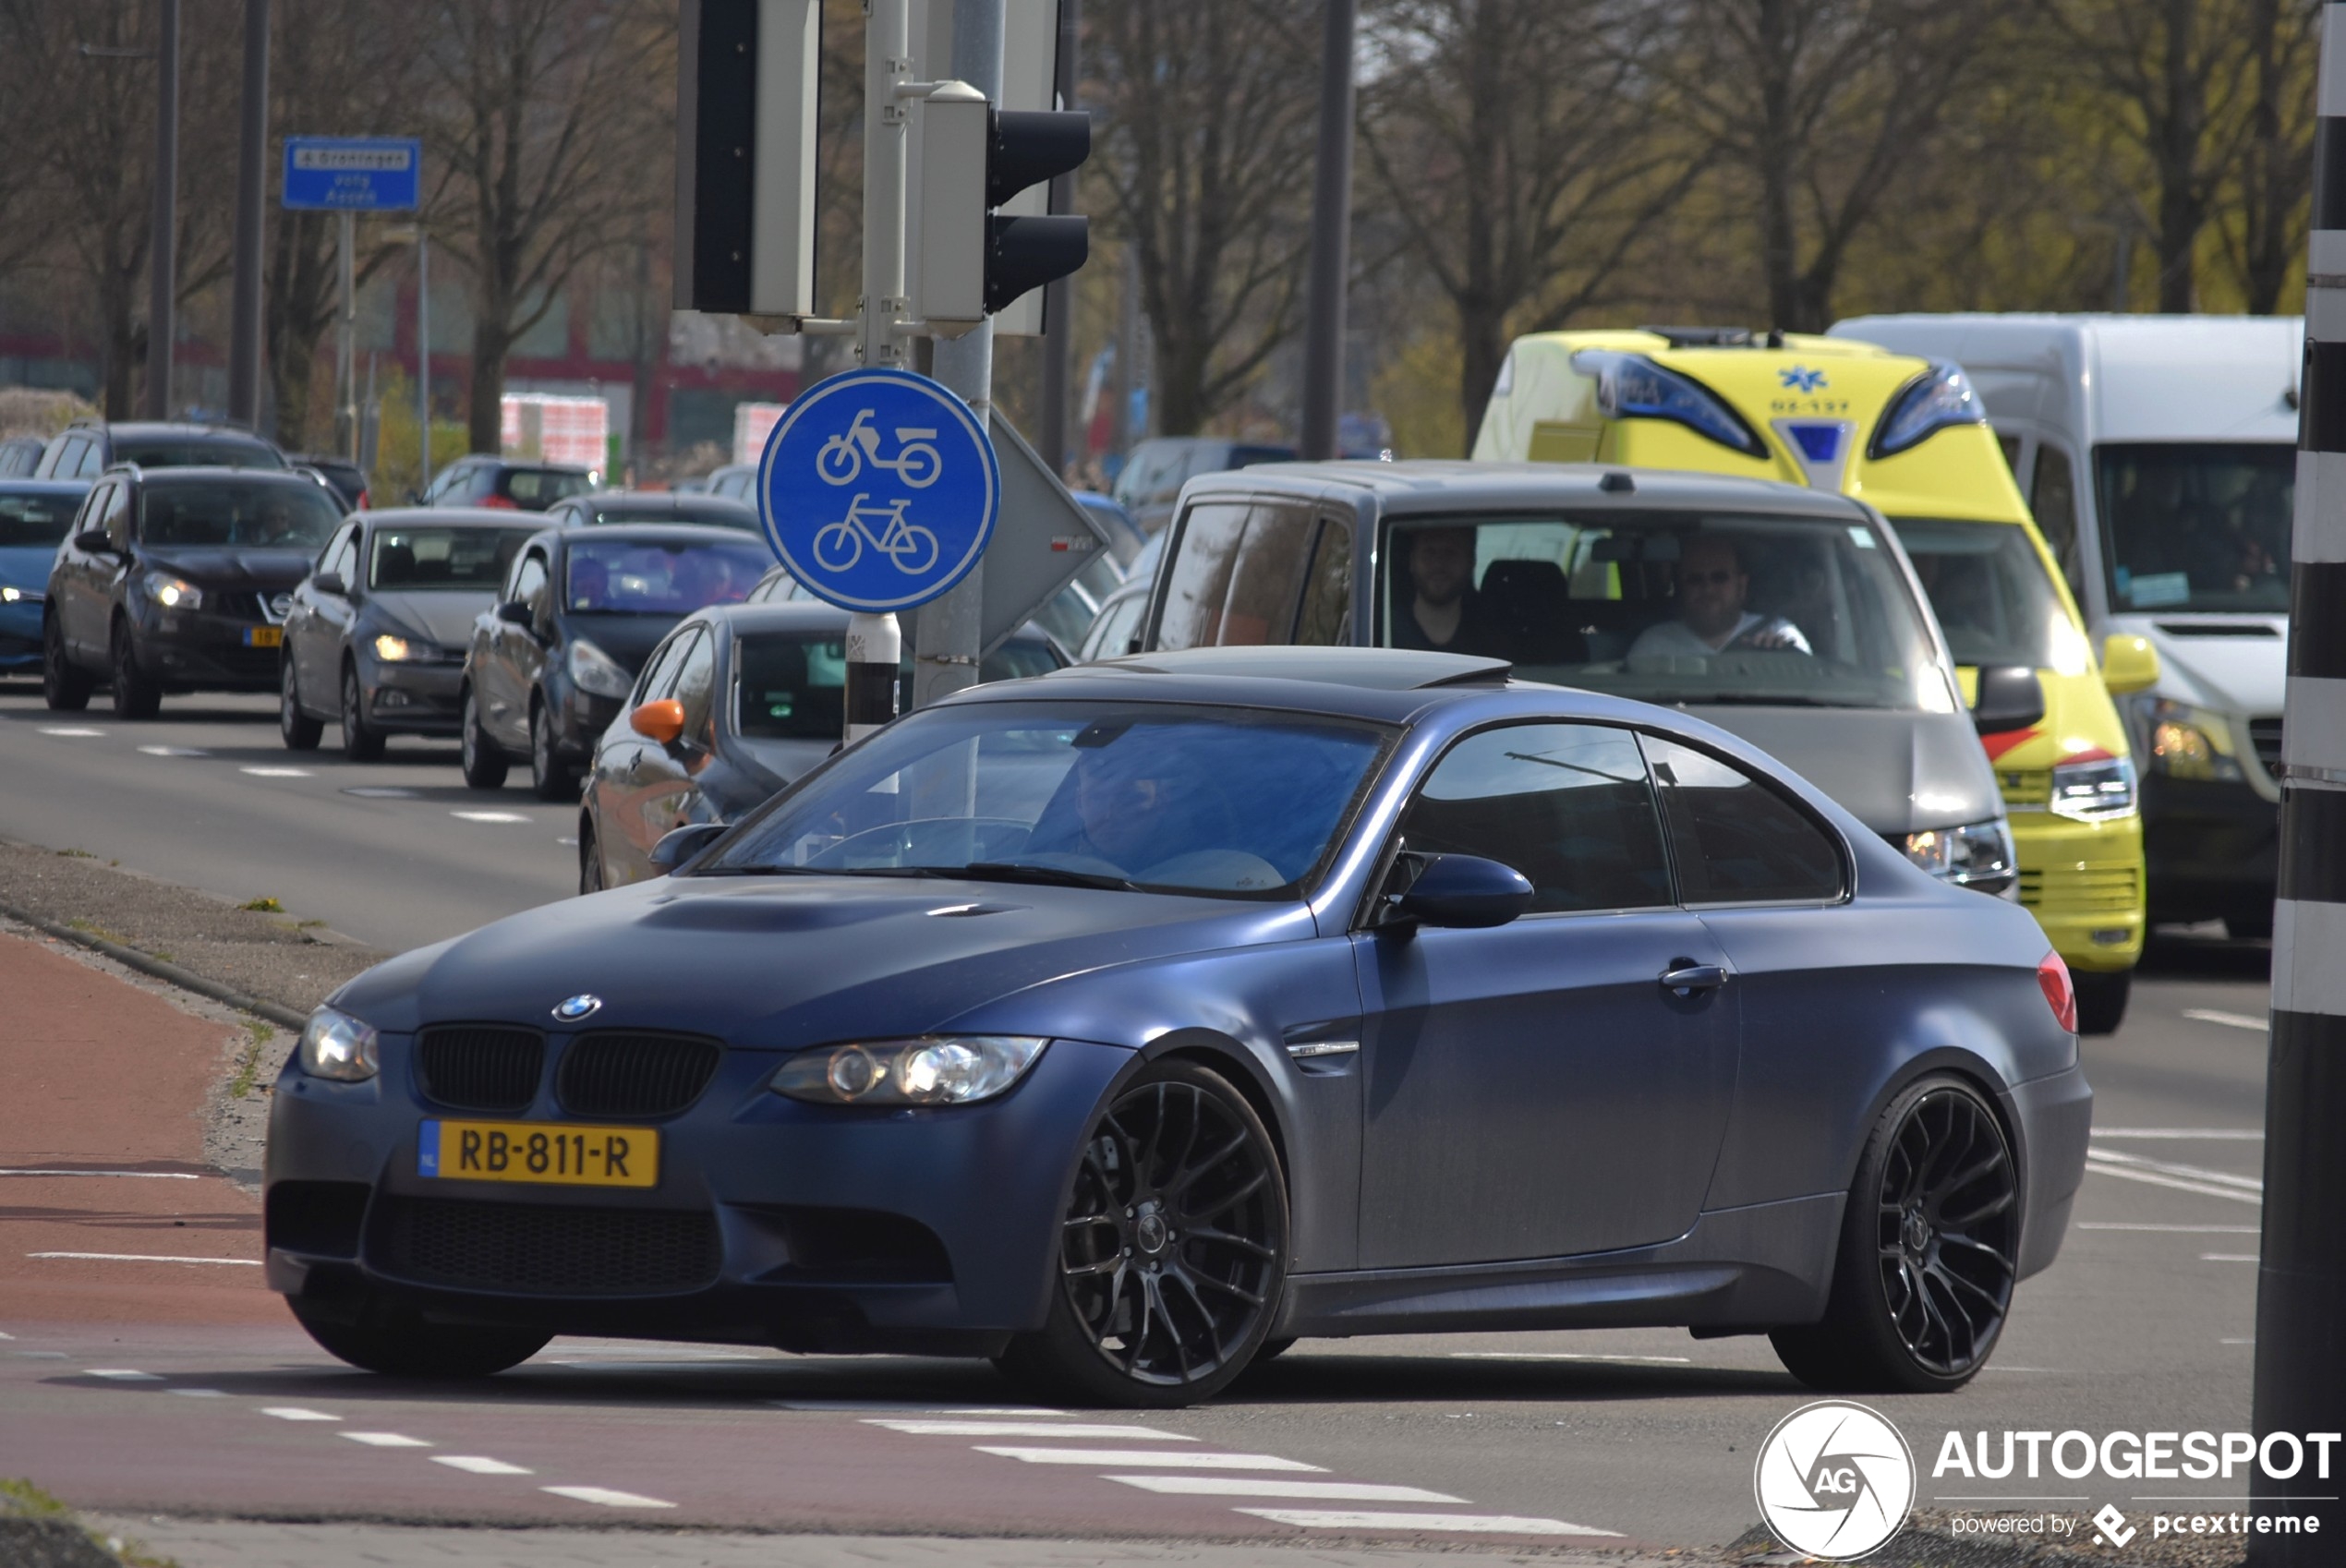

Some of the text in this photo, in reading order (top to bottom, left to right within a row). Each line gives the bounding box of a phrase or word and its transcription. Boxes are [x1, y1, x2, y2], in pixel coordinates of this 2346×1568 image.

[318, 150, 405, 168] Groningen
[421, 1129, 630, 1177] NL RB-811-R
